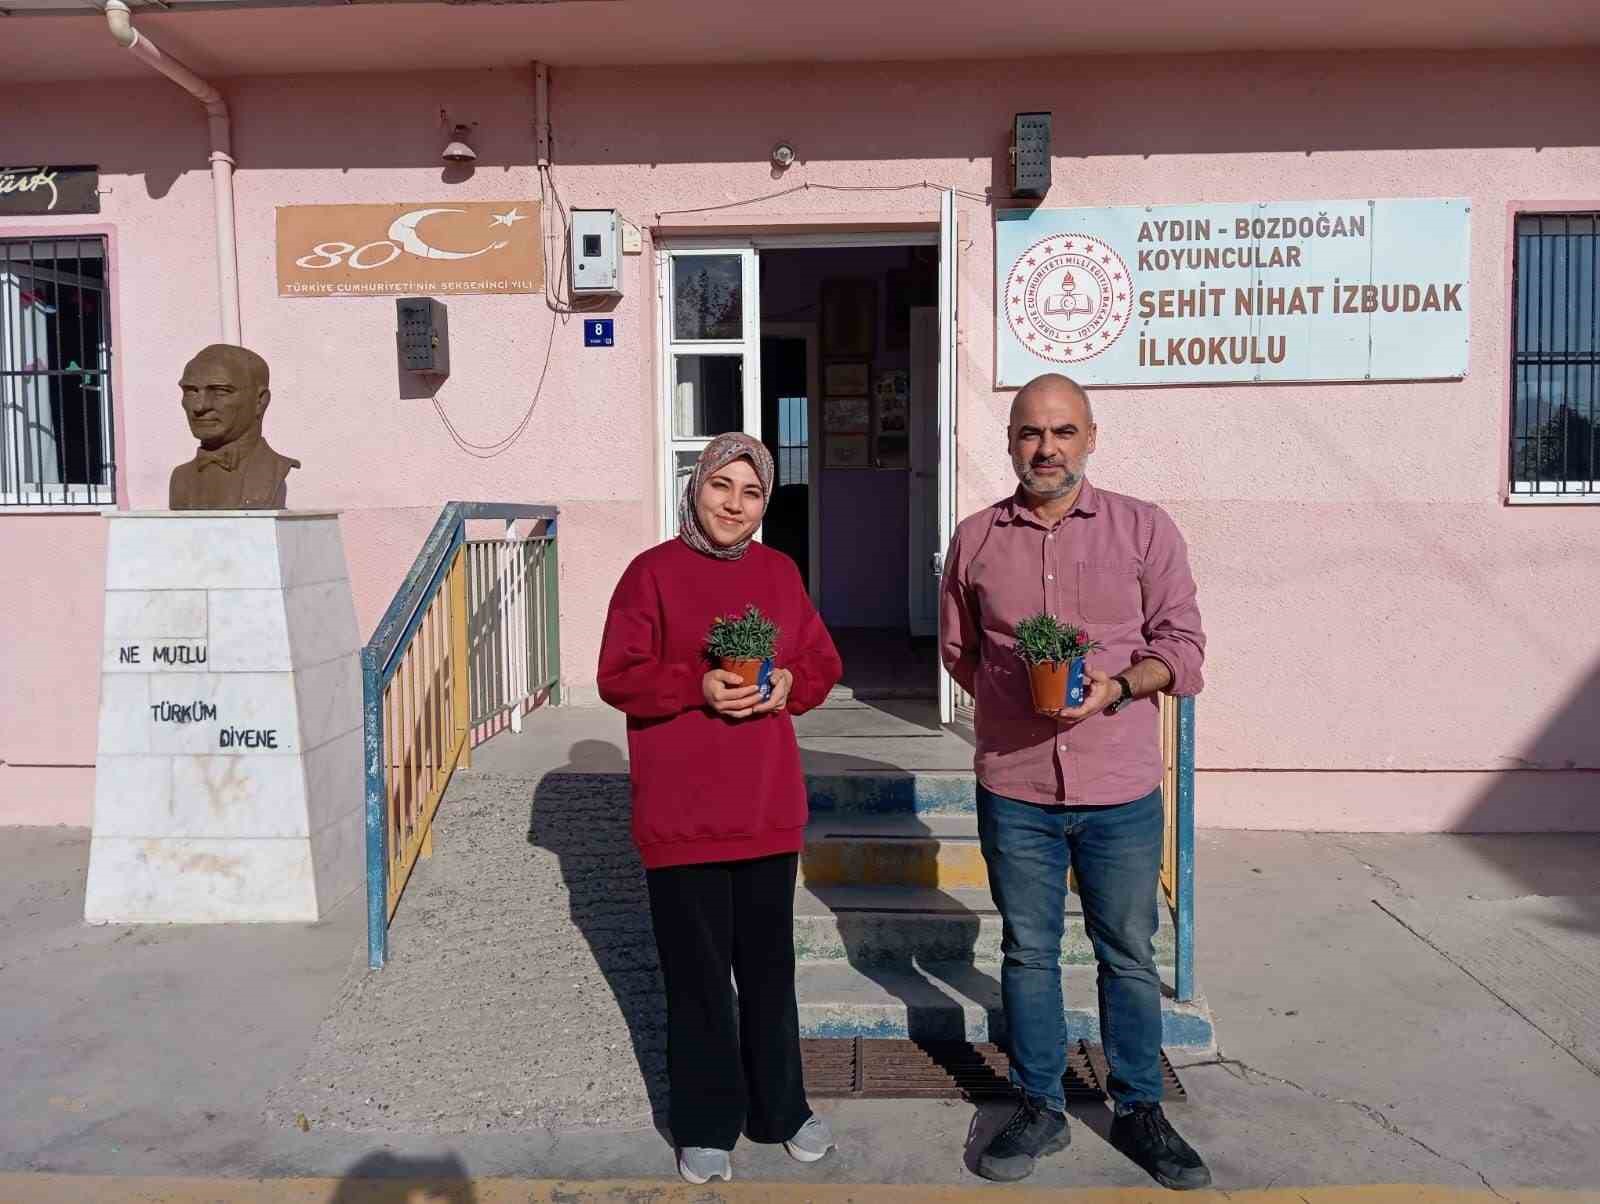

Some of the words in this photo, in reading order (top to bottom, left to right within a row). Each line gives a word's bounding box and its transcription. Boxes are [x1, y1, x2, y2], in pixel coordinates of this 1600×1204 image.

[1138, 218, 1211, 242] AYDIN
[1234, 212, 1366, 240] BOZDOĞAN
[1138, 246, 1301, 271] KOYUNCULAR
[1138, 281, 1226, 326] ŞEHİT
[1235, 280, 1325, 316] NİHAT
[1333, 278, 1463, 313] İZBUDAK
[595, 323, 602, 336] 8
[1138, 331, 1287, 367] İLKOKULU
[120, 646, 140, 663] NE
[152, 645, 207, 664] MUTLU
[151, 701, 217, 723] TÜRKÜM
[219, 726, 278, 748] DİYENE
